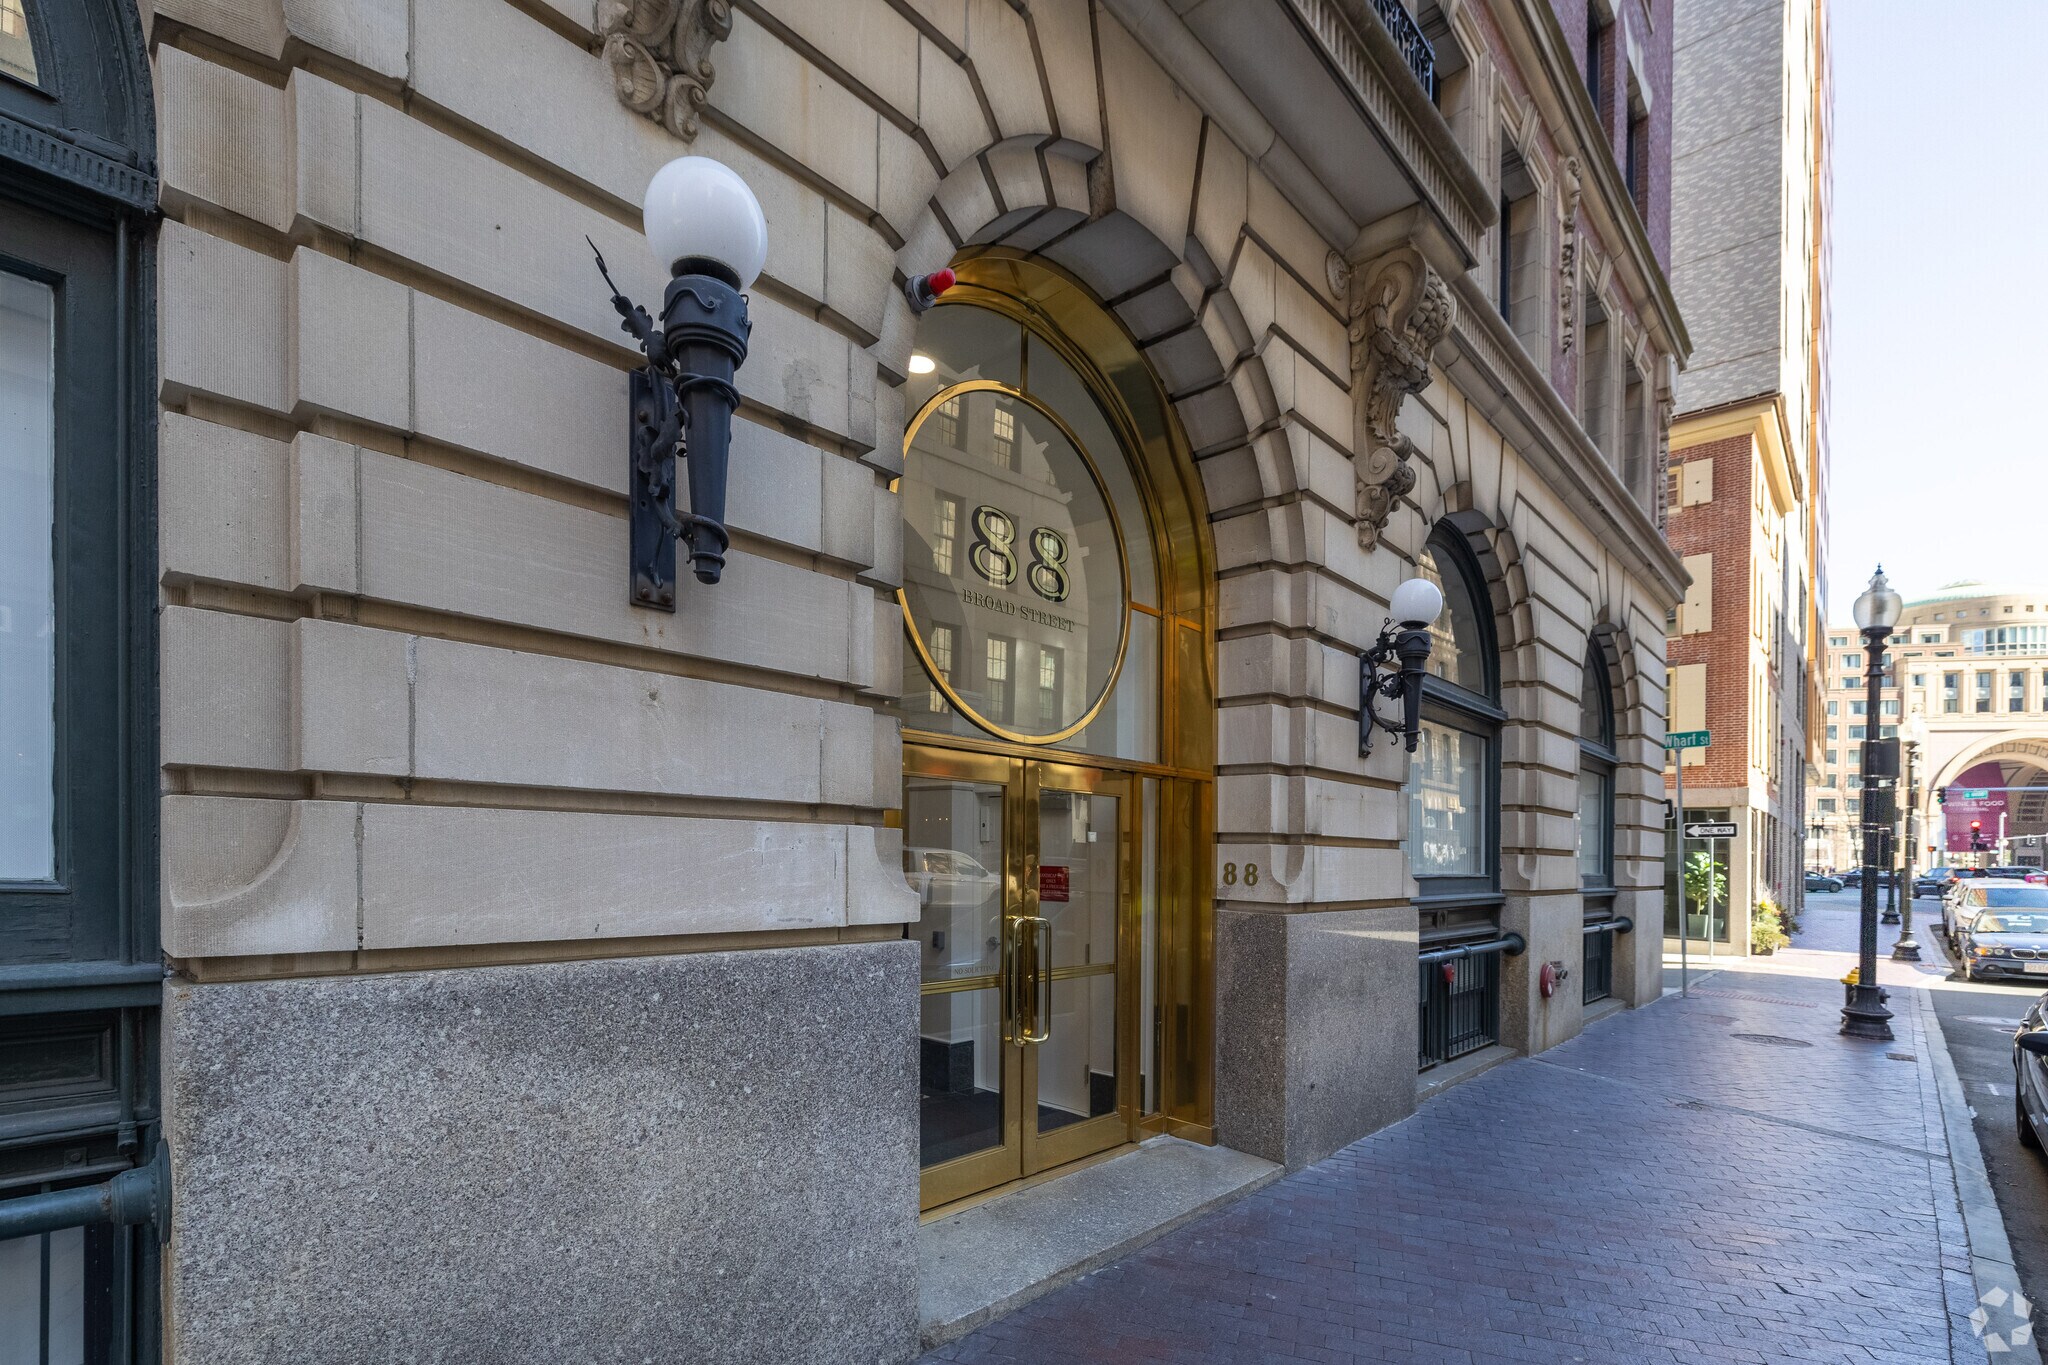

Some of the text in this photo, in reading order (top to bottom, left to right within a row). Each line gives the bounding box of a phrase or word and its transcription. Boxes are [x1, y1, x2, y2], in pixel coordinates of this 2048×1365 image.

[968, 504, 1071, 602] 88
[962, 588, 1075, 633] BROAD STREET
[1664, 733, 1709, 748] Wharf St
[1223, 862, 1259, 886] 88
[954, 967, 963, 975] NO
